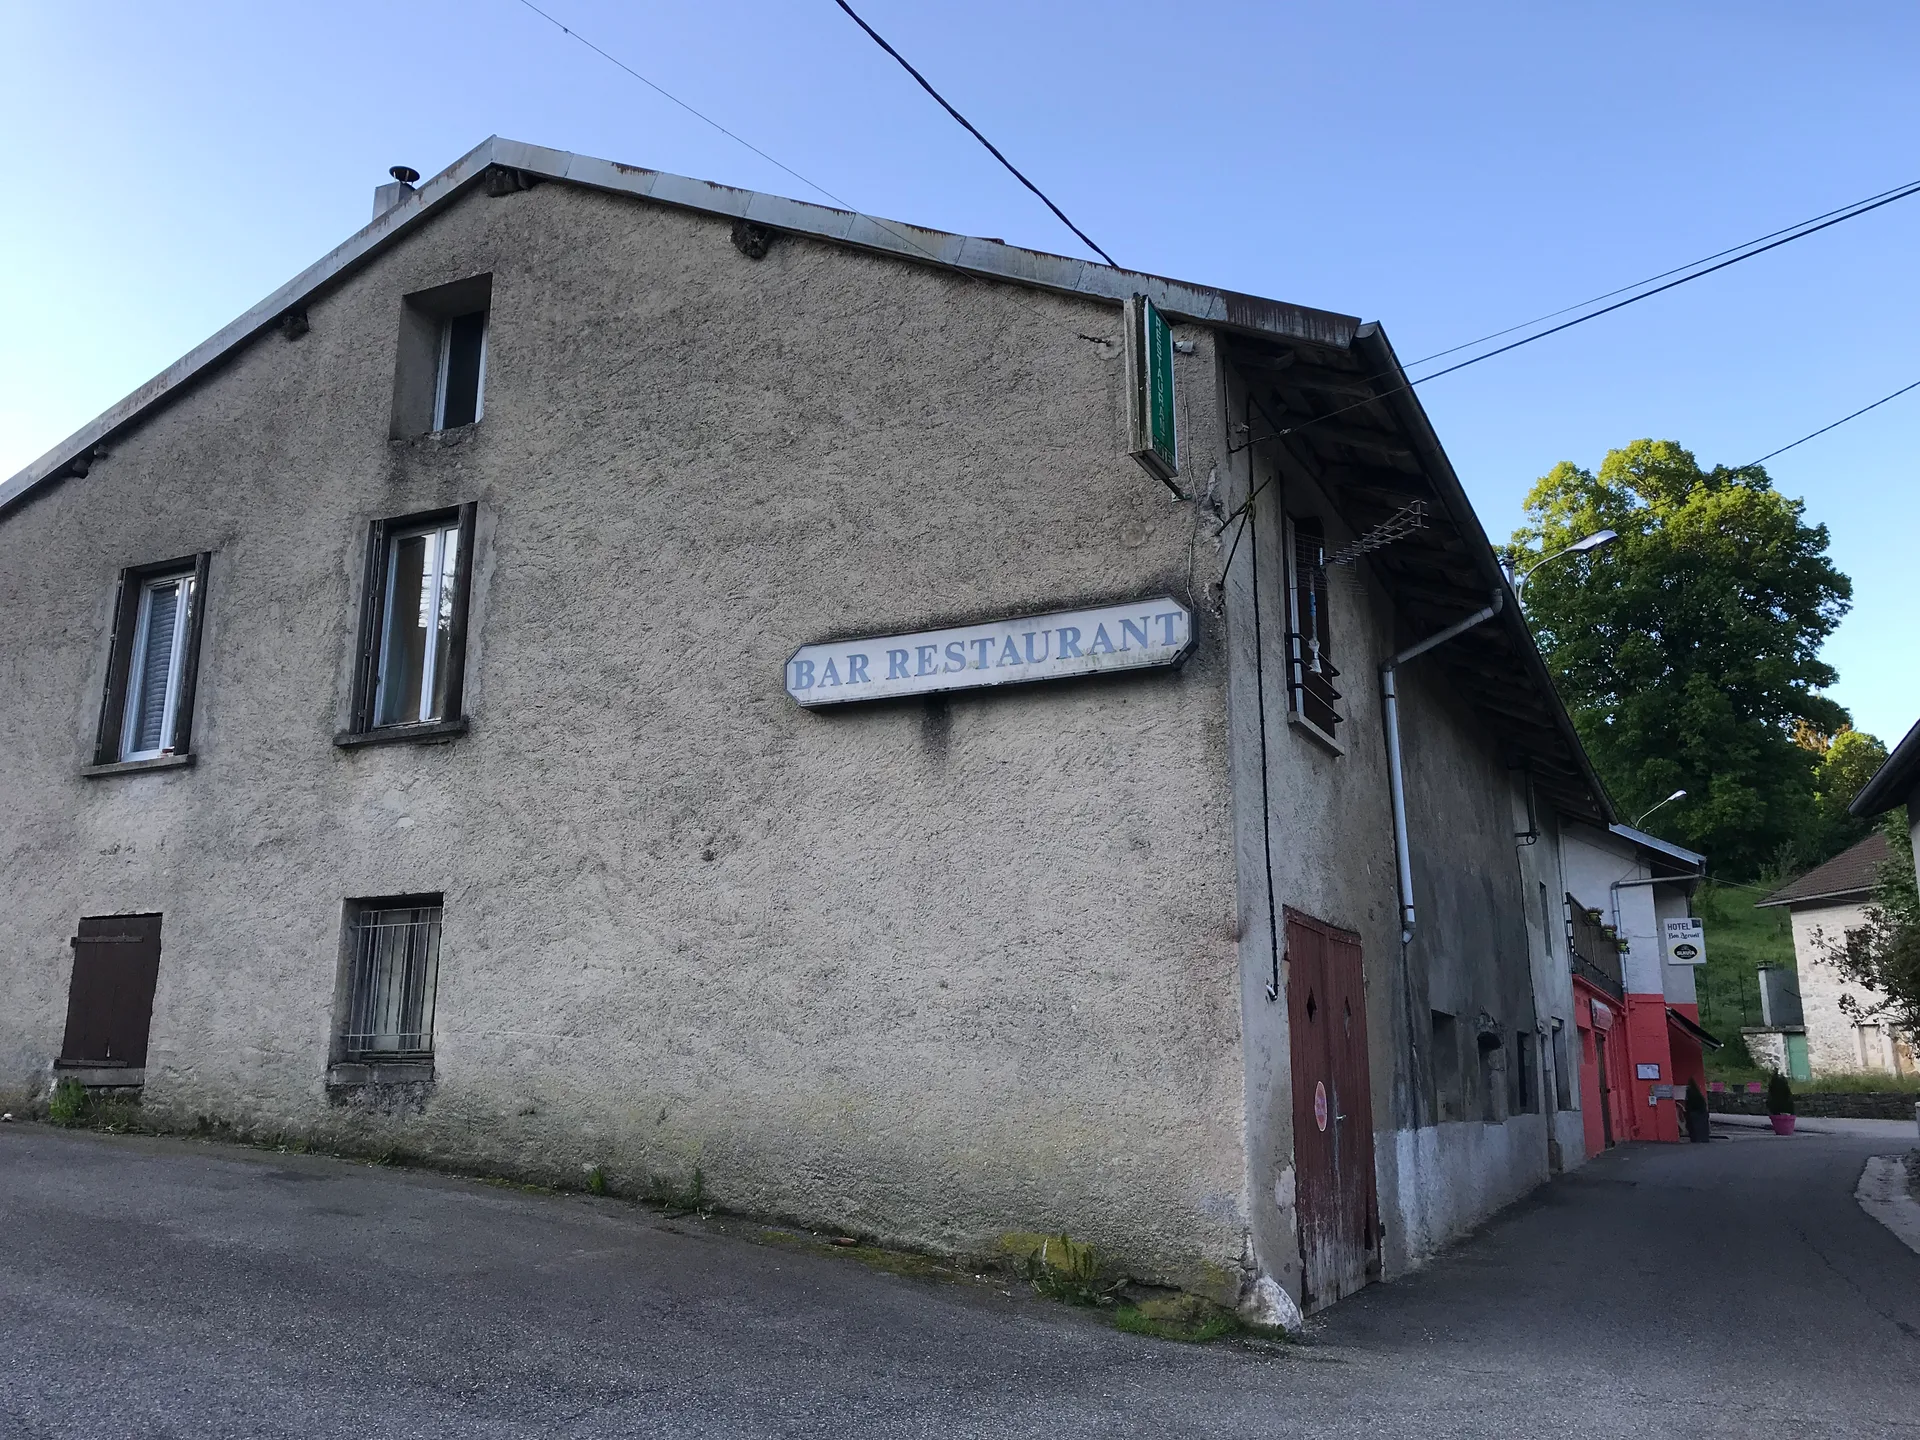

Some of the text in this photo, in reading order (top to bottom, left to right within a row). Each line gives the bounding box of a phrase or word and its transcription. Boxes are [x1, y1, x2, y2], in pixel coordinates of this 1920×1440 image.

[1155, 315, 1165, 439] RESTAURANT
[791, 610, 1183, 691] BAR RESTAURANT
